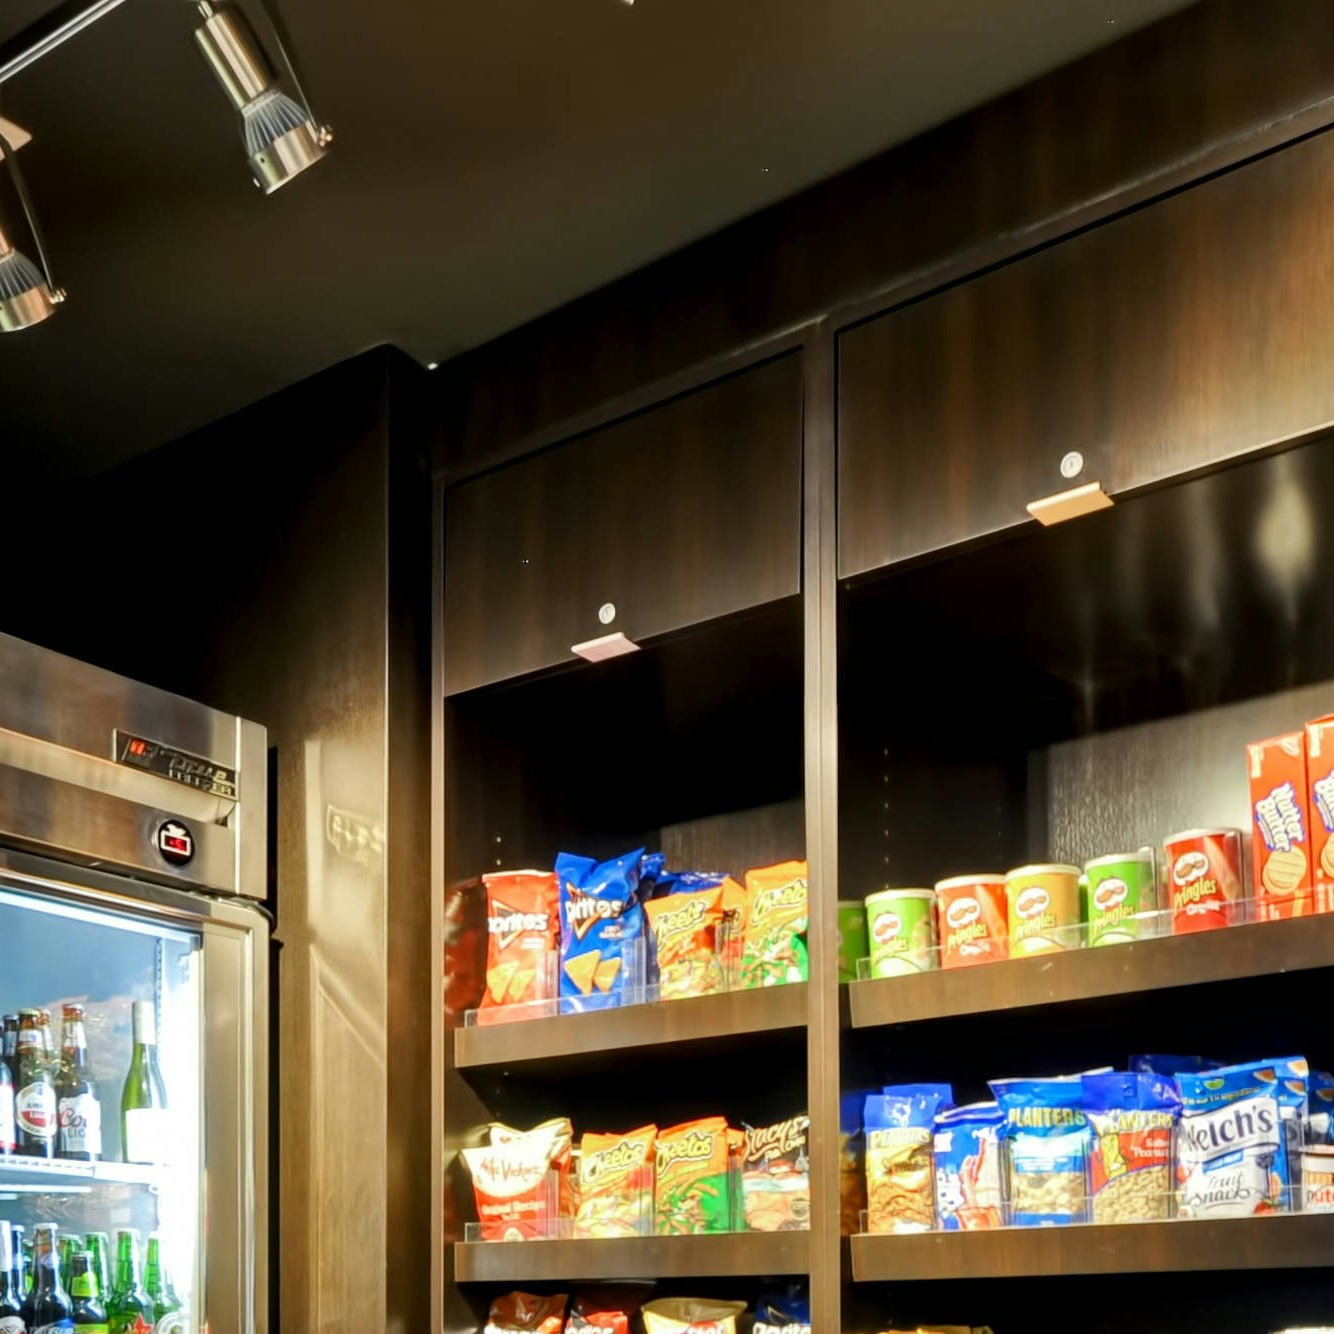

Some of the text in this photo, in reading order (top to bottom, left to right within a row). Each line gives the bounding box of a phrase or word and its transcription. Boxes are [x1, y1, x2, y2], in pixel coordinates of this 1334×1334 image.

[1172, 876, 1217, 913] Pringles
[1015, 914, 1056, 938] Pringles
[1093, 905, 1135, 937] Pringles
[948, 922, 988, 951] Pringles
[1008, 1107, 1087, 1127] PLANTERS
[1187, 1106, 1274, 1153] Welch's
